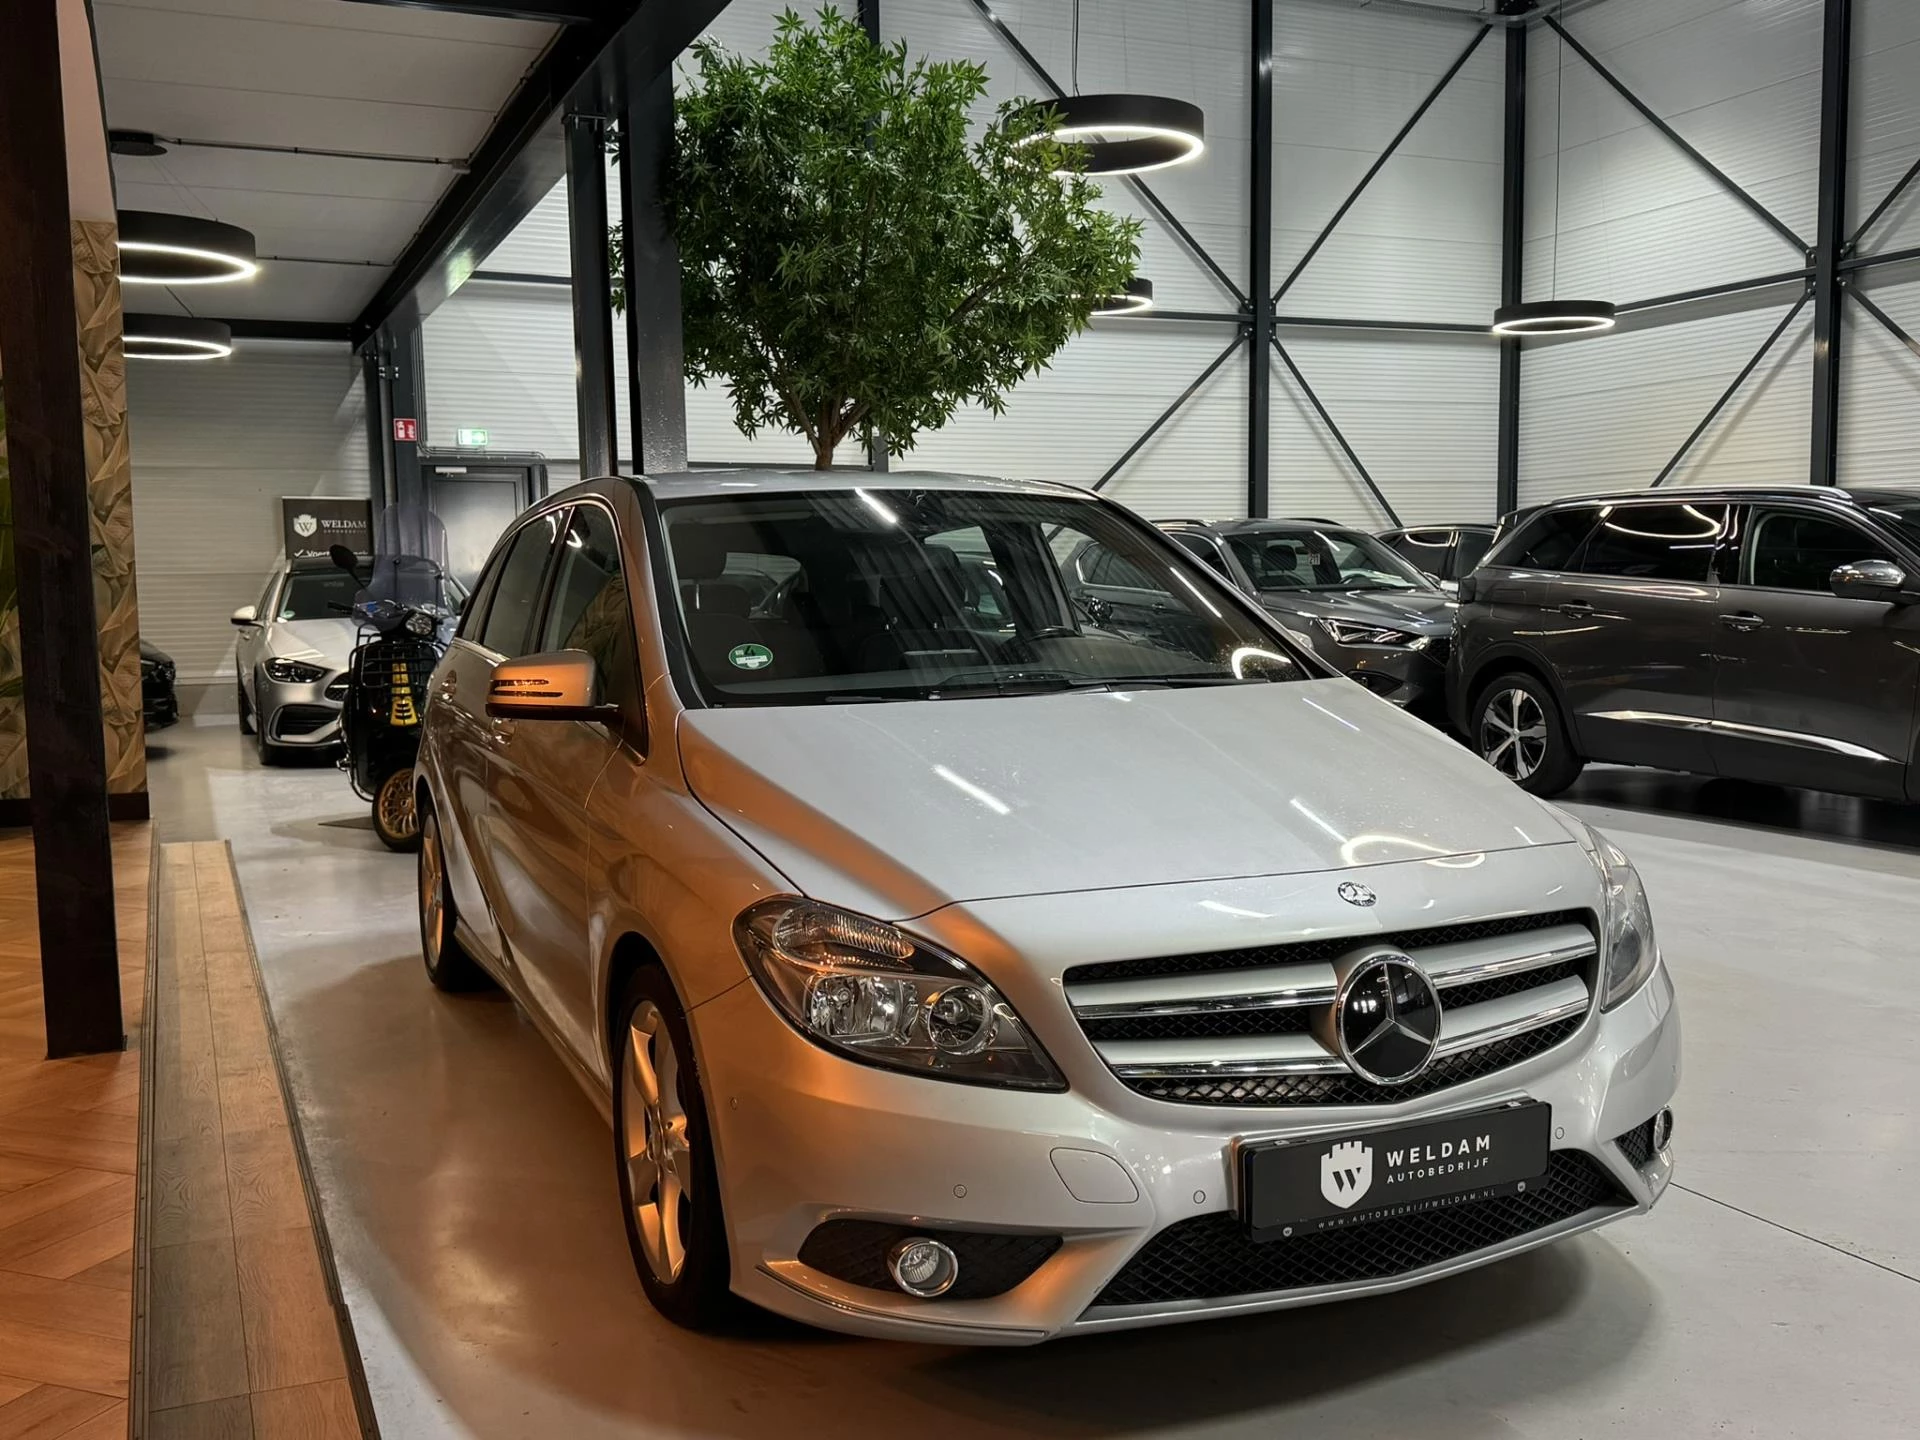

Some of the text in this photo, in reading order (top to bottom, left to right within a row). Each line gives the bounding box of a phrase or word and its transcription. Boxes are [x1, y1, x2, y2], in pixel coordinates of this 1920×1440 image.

[321, 520, 366, 529] WELDAM
[1386, 1134, 1490, 1168] WELDAM
[1332, 1166, 1362, 1192] W
[1386, 1157, 1489, 1184] AUTOBEDRIJF
[1318, 1188, 1496, 1229] WWW.AUTOBEDRIJFWELDAM.NL
